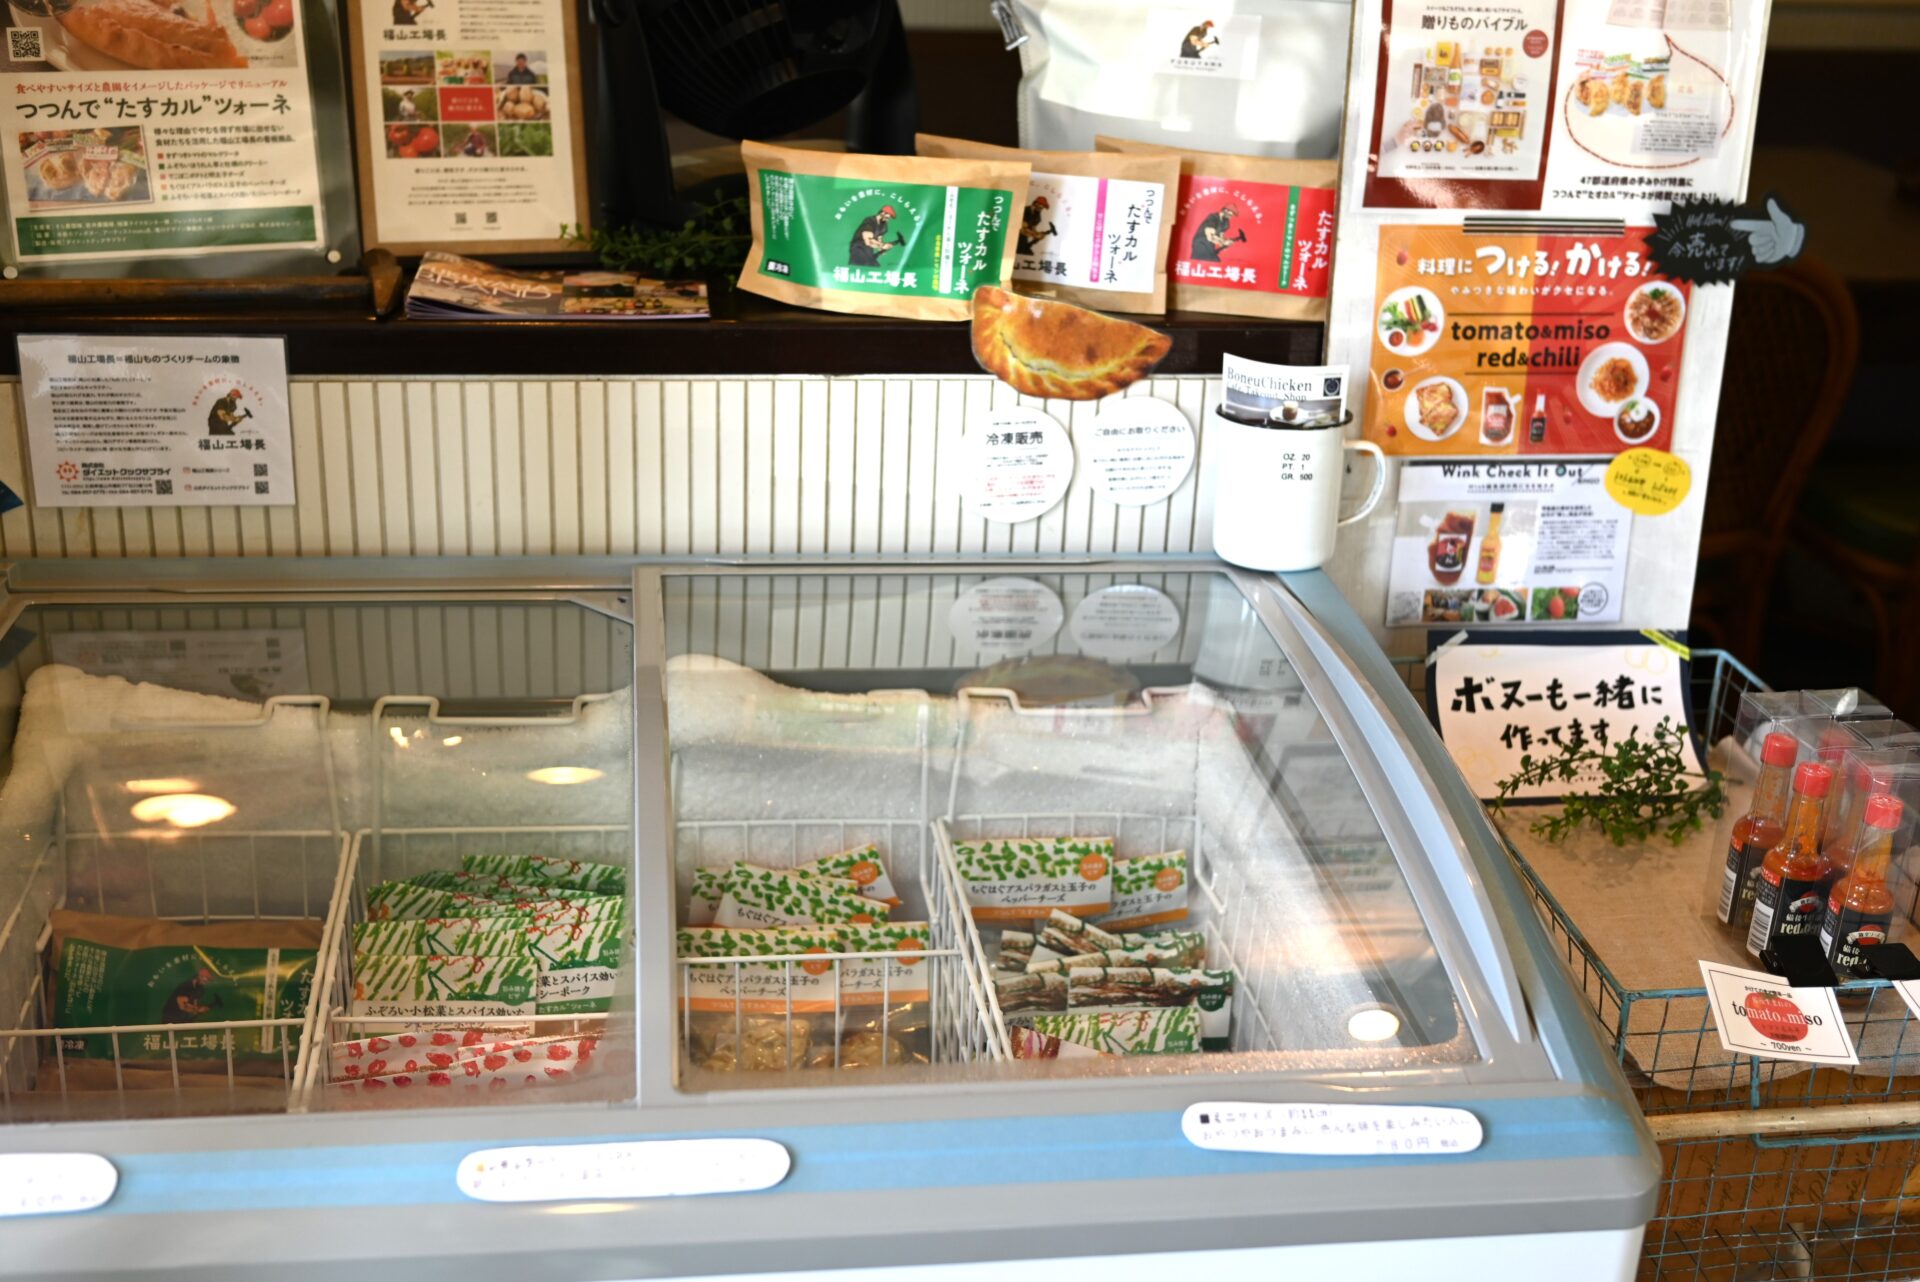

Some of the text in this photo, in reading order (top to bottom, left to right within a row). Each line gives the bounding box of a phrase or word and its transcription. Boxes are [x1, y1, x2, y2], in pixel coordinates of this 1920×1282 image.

[1421, 15, 1528, 31] 贈りものバイブル
[383, 29, 447, 41] 福山工場長
[16, 79, 288, 94] 食べやすいサイズと農園をイメージしたパッケージでリニューアル
[972, 211, 992, 272] たすカル
[1122, 204, 1141, 262] たすカル
[1312, 210, 1334, 270] たすカル
[1668, 232, 1729, 259] 今売れて
[953, 241, 974, 295] ツォーネ
[1103, 233, 1121, 284] ツォーネ
[1292, 239, 1314, 290] ツォーネ
[1417, 242, 1652, 278] 料理に つける! かける!
[833, 266, 918, 289] 福山工場長
[1175, 260, 1257, 284] 福山工場長
[1450, 285, 1615, 297] やみつきな味わいがクセになる。
[1451, 319, 1611, 342] tomato&miso
[1476, 346, 1580, 368] red&chili
[1227, 367, 1312, 392] BoneuChicken
[986, 430, 1044, 446] 冷凍販売
[1094, 426, 1186, 437] ご自由にお取りください
[198, 438, 267, 451] 福山工場長
[1301, 453, 1311, 461] 20
[82, 468, 171, 476] ダイエットクックサプライ
[1441, 463, 1583, 479] Wink Check It Out
[1451, 674, 1663, 713] ボヌーも一緒に
[1001, 893, 1066, 904] ペッパーチーズ
[538, 970, 624, 987] 菜とスパイス効い
[1770, 1041, 1802, 1052] 700yen
